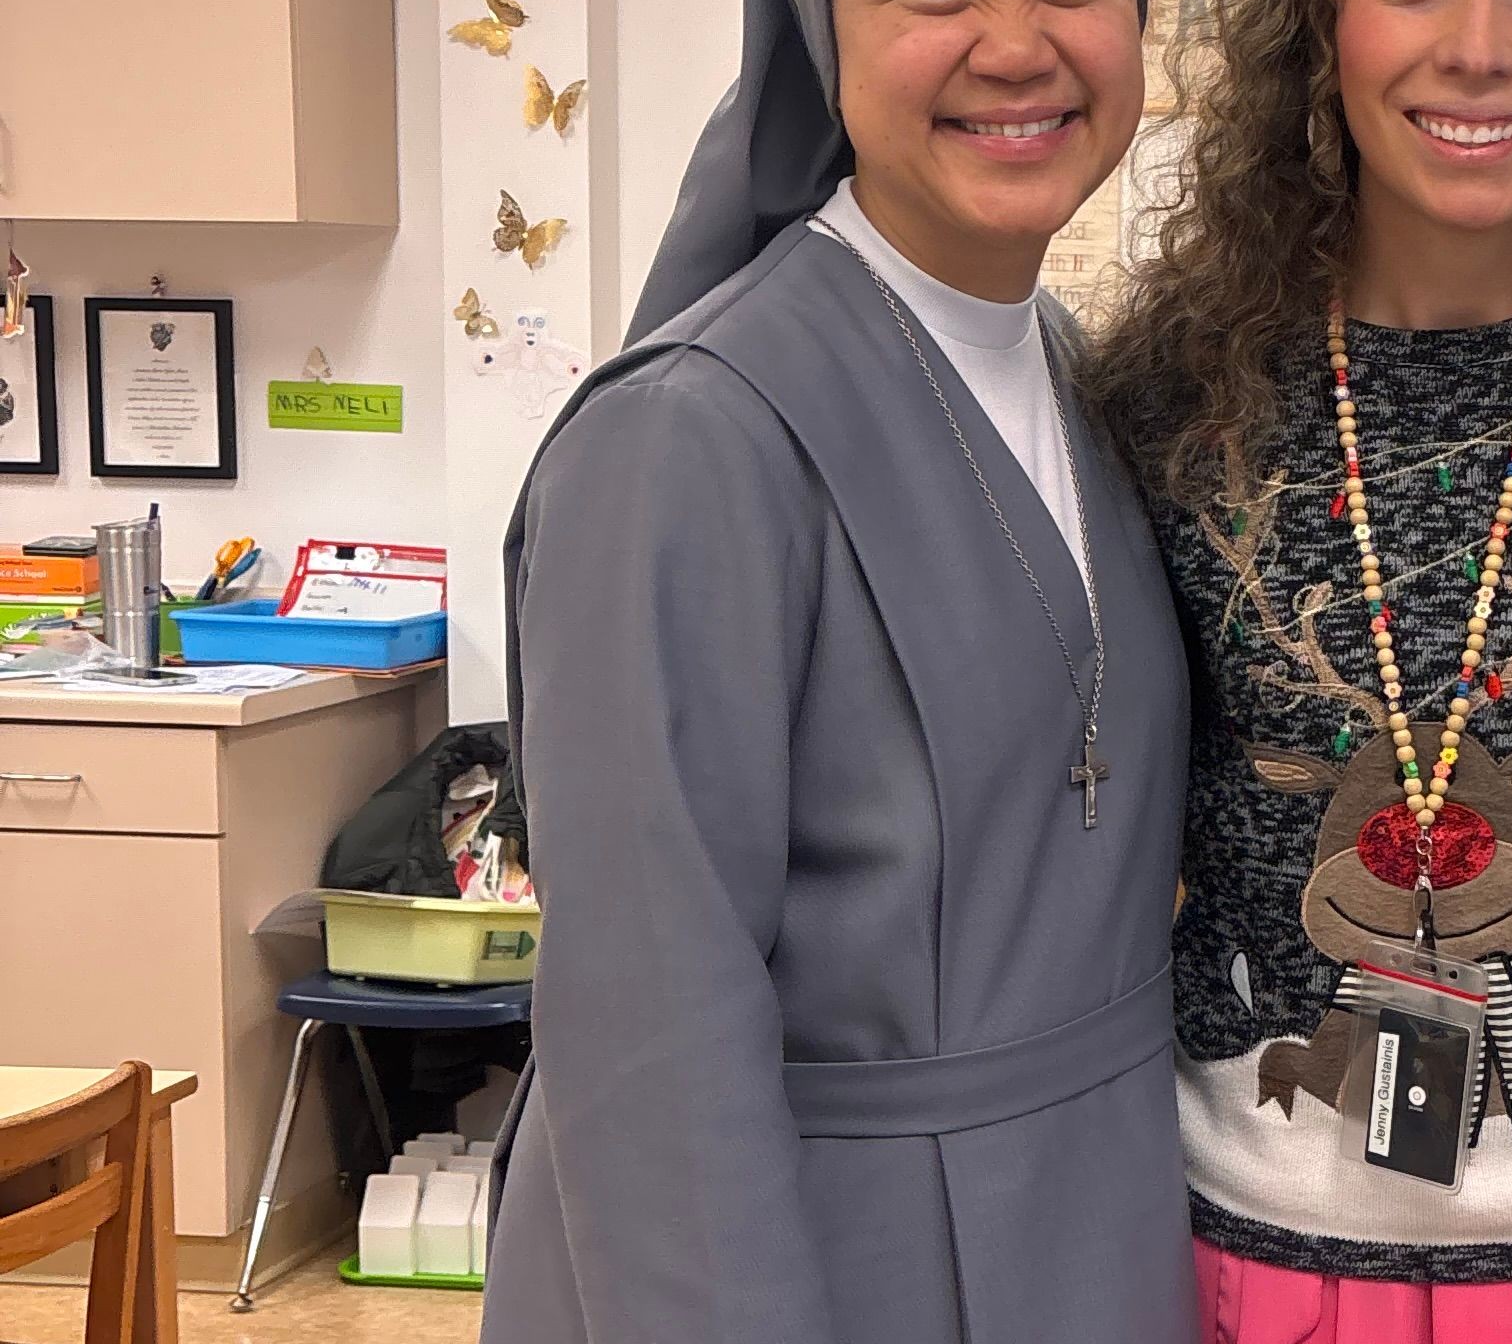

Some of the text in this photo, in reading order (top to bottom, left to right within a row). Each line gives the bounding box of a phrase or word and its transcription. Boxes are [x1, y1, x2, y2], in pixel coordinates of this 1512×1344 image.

[275, 395, 322, 414] MRS
[1374, 1038, 1395, 1146] Jenny Gustainis
